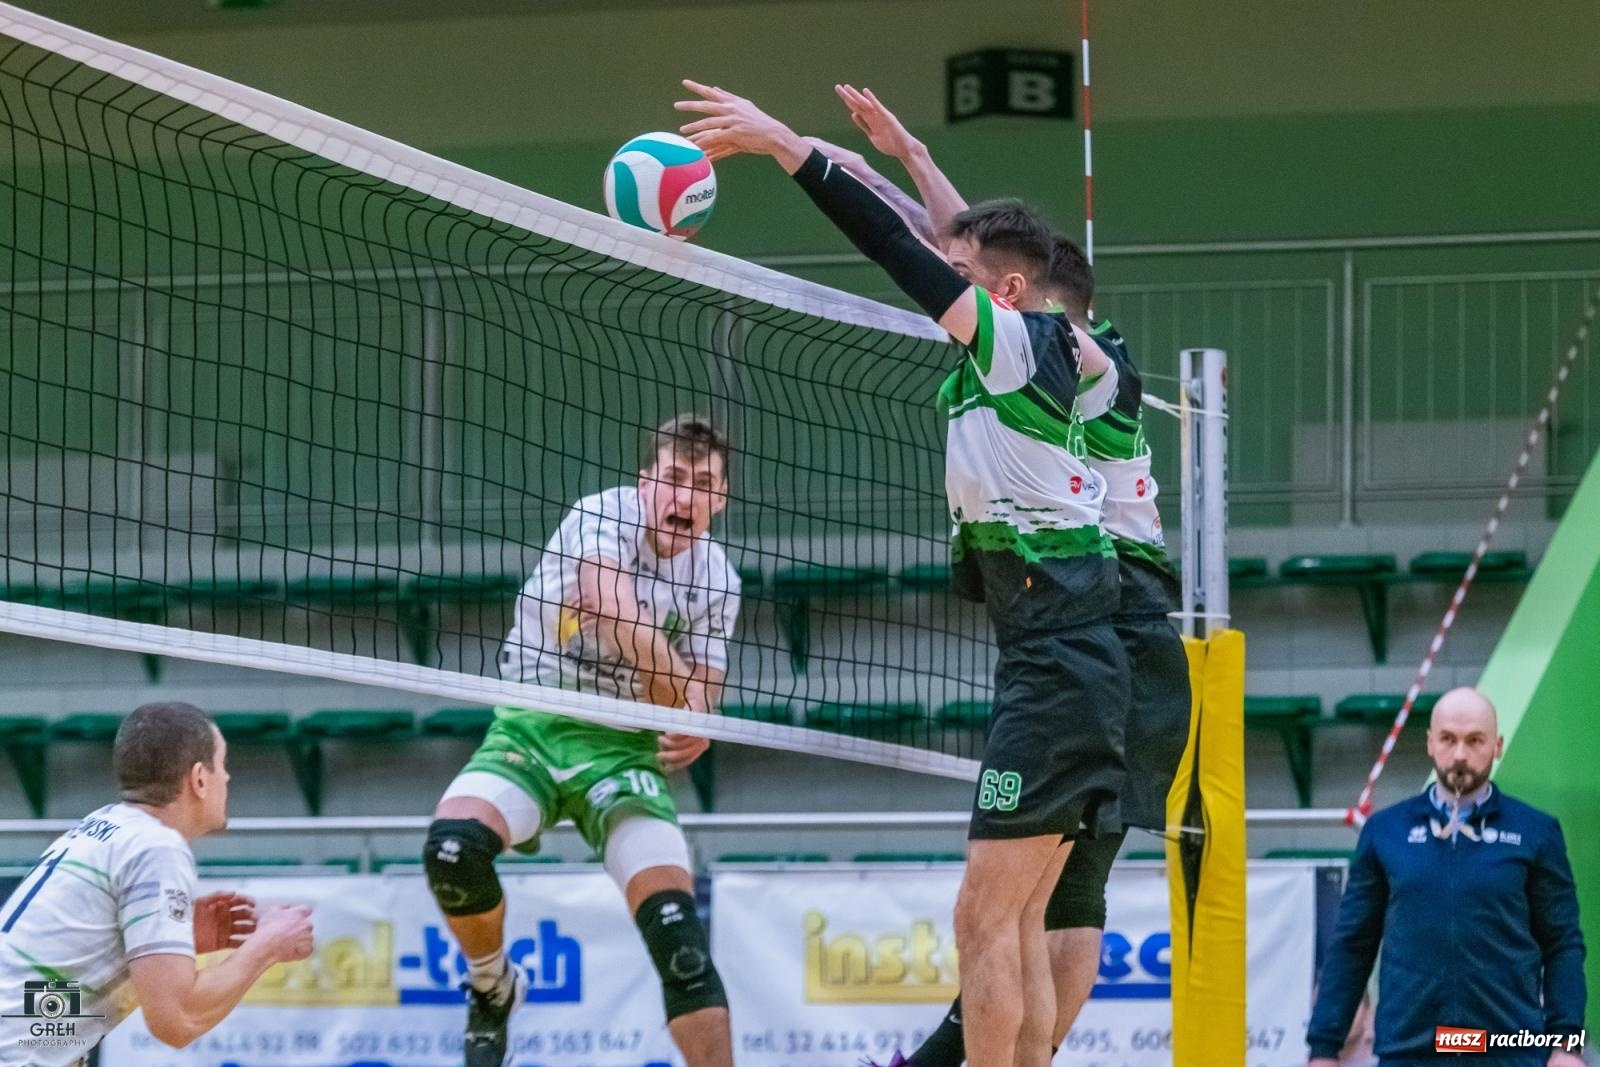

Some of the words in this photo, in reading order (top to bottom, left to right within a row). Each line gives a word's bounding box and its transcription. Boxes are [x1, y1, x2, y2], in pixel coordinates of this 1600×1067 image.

[1007, 70, 1057, 112] B
[623, 769, 659, 797] 10
[978, 769, 1022, 811] 69
